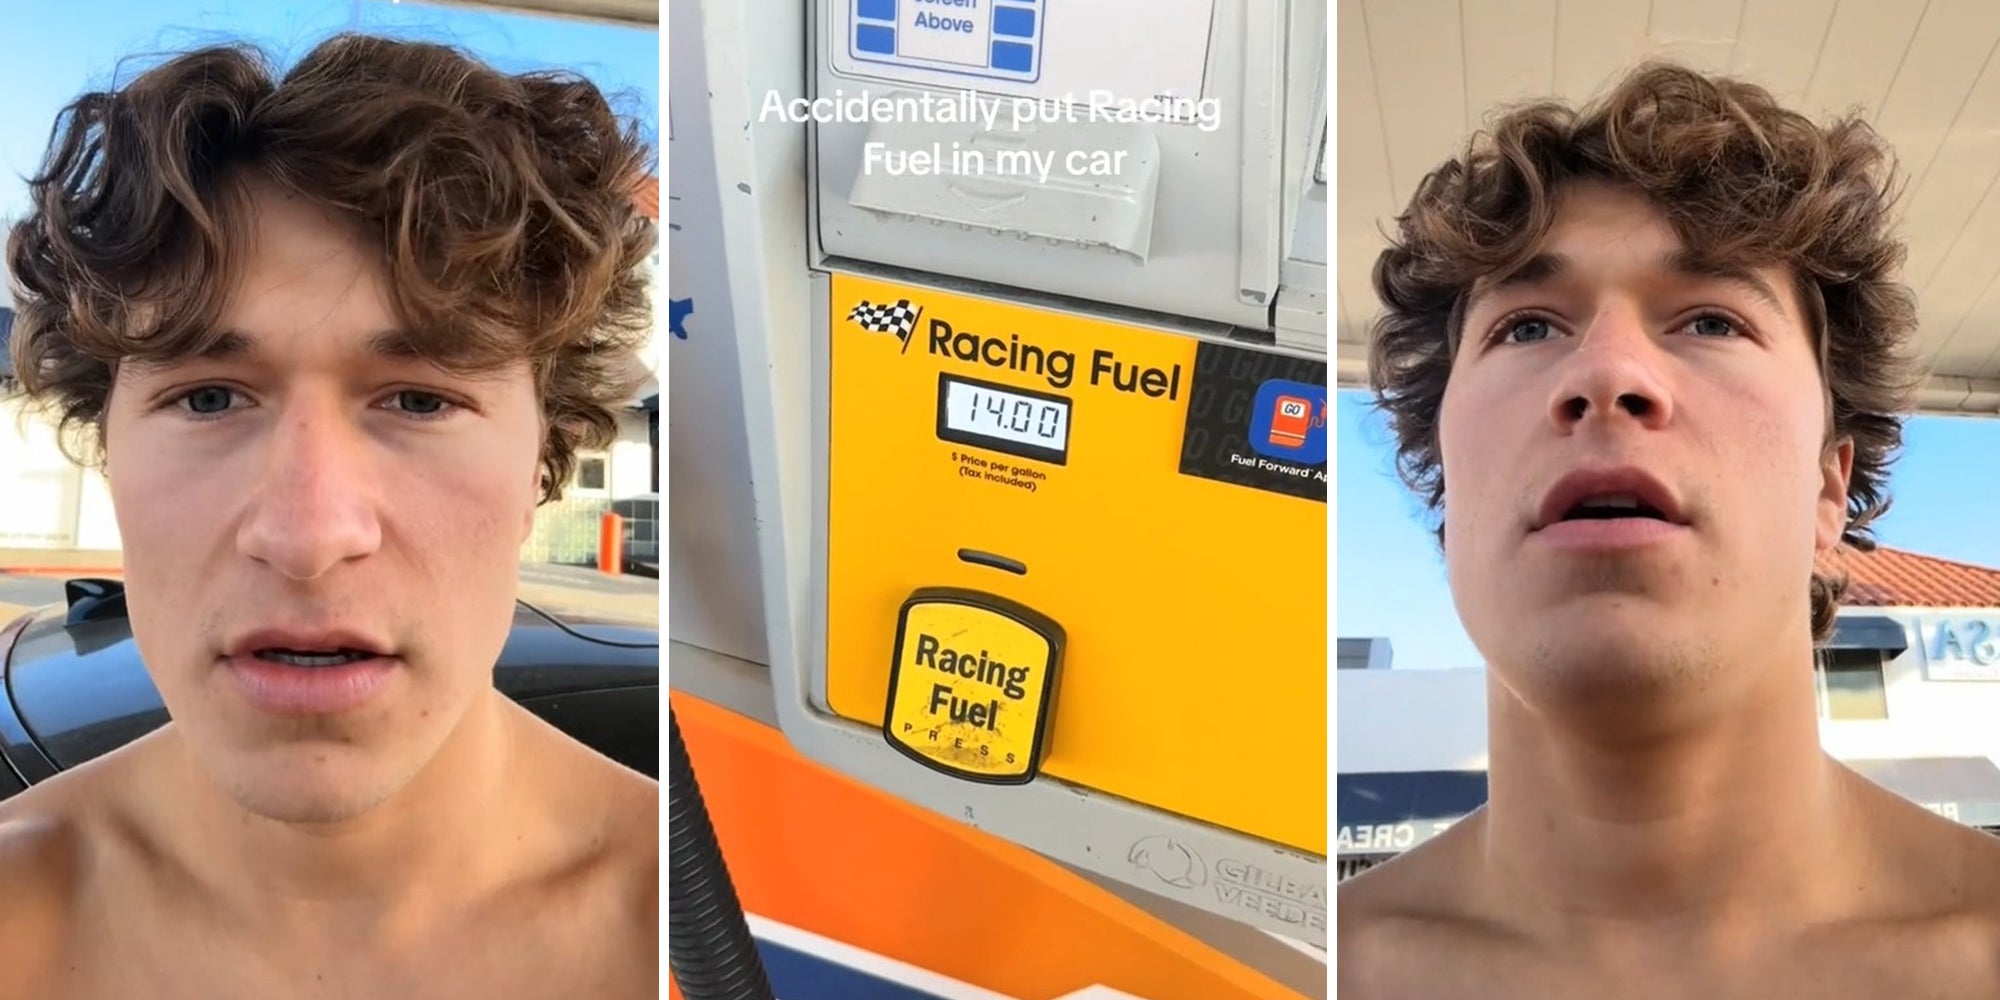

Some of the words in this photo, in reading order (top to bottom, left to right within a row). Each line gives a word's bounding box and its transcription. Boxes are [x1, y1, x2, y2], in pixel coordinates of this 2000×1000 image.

[914, 11, 974, 33] Above
[928, 318, 1075, 389] Racing
[1090, 349, 1181, 401] Fuel
[970, 392, 1060, 439] 14.00
[1284, 403, 1301, 415] GO
[951, 451, 958, 462] $
[960, 453, 987, 468] Price
[990, 461, 1008, 472] per
[1011, 467, 1046, 481] gallon
[1230, 453, 1256, 467] Fuel
[959, 466, 982, 478] (Tax
[984, 471, 1037, 493] included)
[915, 633, 1030, 700] Racing
[929, 683, 998, 731] Fuel
